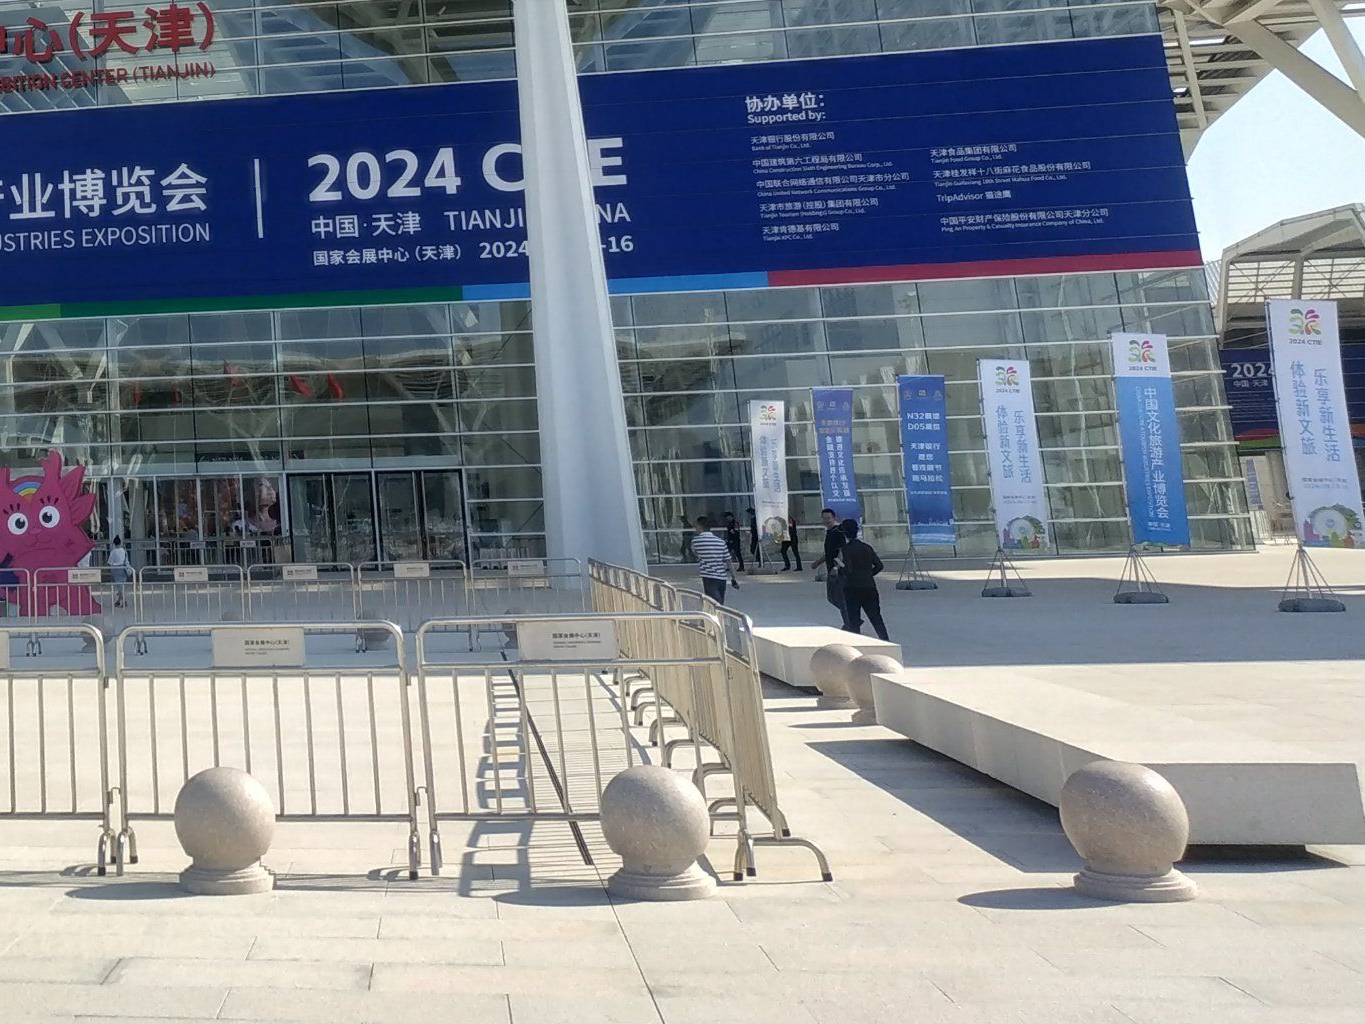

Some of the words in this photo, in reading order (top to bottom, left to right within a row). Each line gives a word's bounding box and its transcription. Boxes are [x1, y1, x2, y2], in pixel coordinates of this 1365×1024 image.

[61, 68, 128, 88] CENTER
[133, 62, 216, 84] (TIANJIN)
[748, 111, 805, 124] Supported
[809, 110, 826, 122] by:
[751, 132, 834, 144] 天津银行股份有限公司
[930, 144, 1017, 157] 天津食品集团有限公司
[307, 147, 461, 202] 2024
[482, 137, 627, 192] CE
[933, 162, 1091, 178] 天津桂发祥十八街麻花食品股份有限公司
[937, 193, 983, 203] TripAdvisor
[940, 208, 1108, 225] 中国平安财产保险股份有限公司天津分公司
[82, 222, 211, 249] EXPOSITION
[762, 223, 839, 235] 天津肯德基有限公司
[313, 243, 462, 266] 国家会展中心（天津）
[1144, 388, 1169, 519] 中国文化旅游产业博览会
